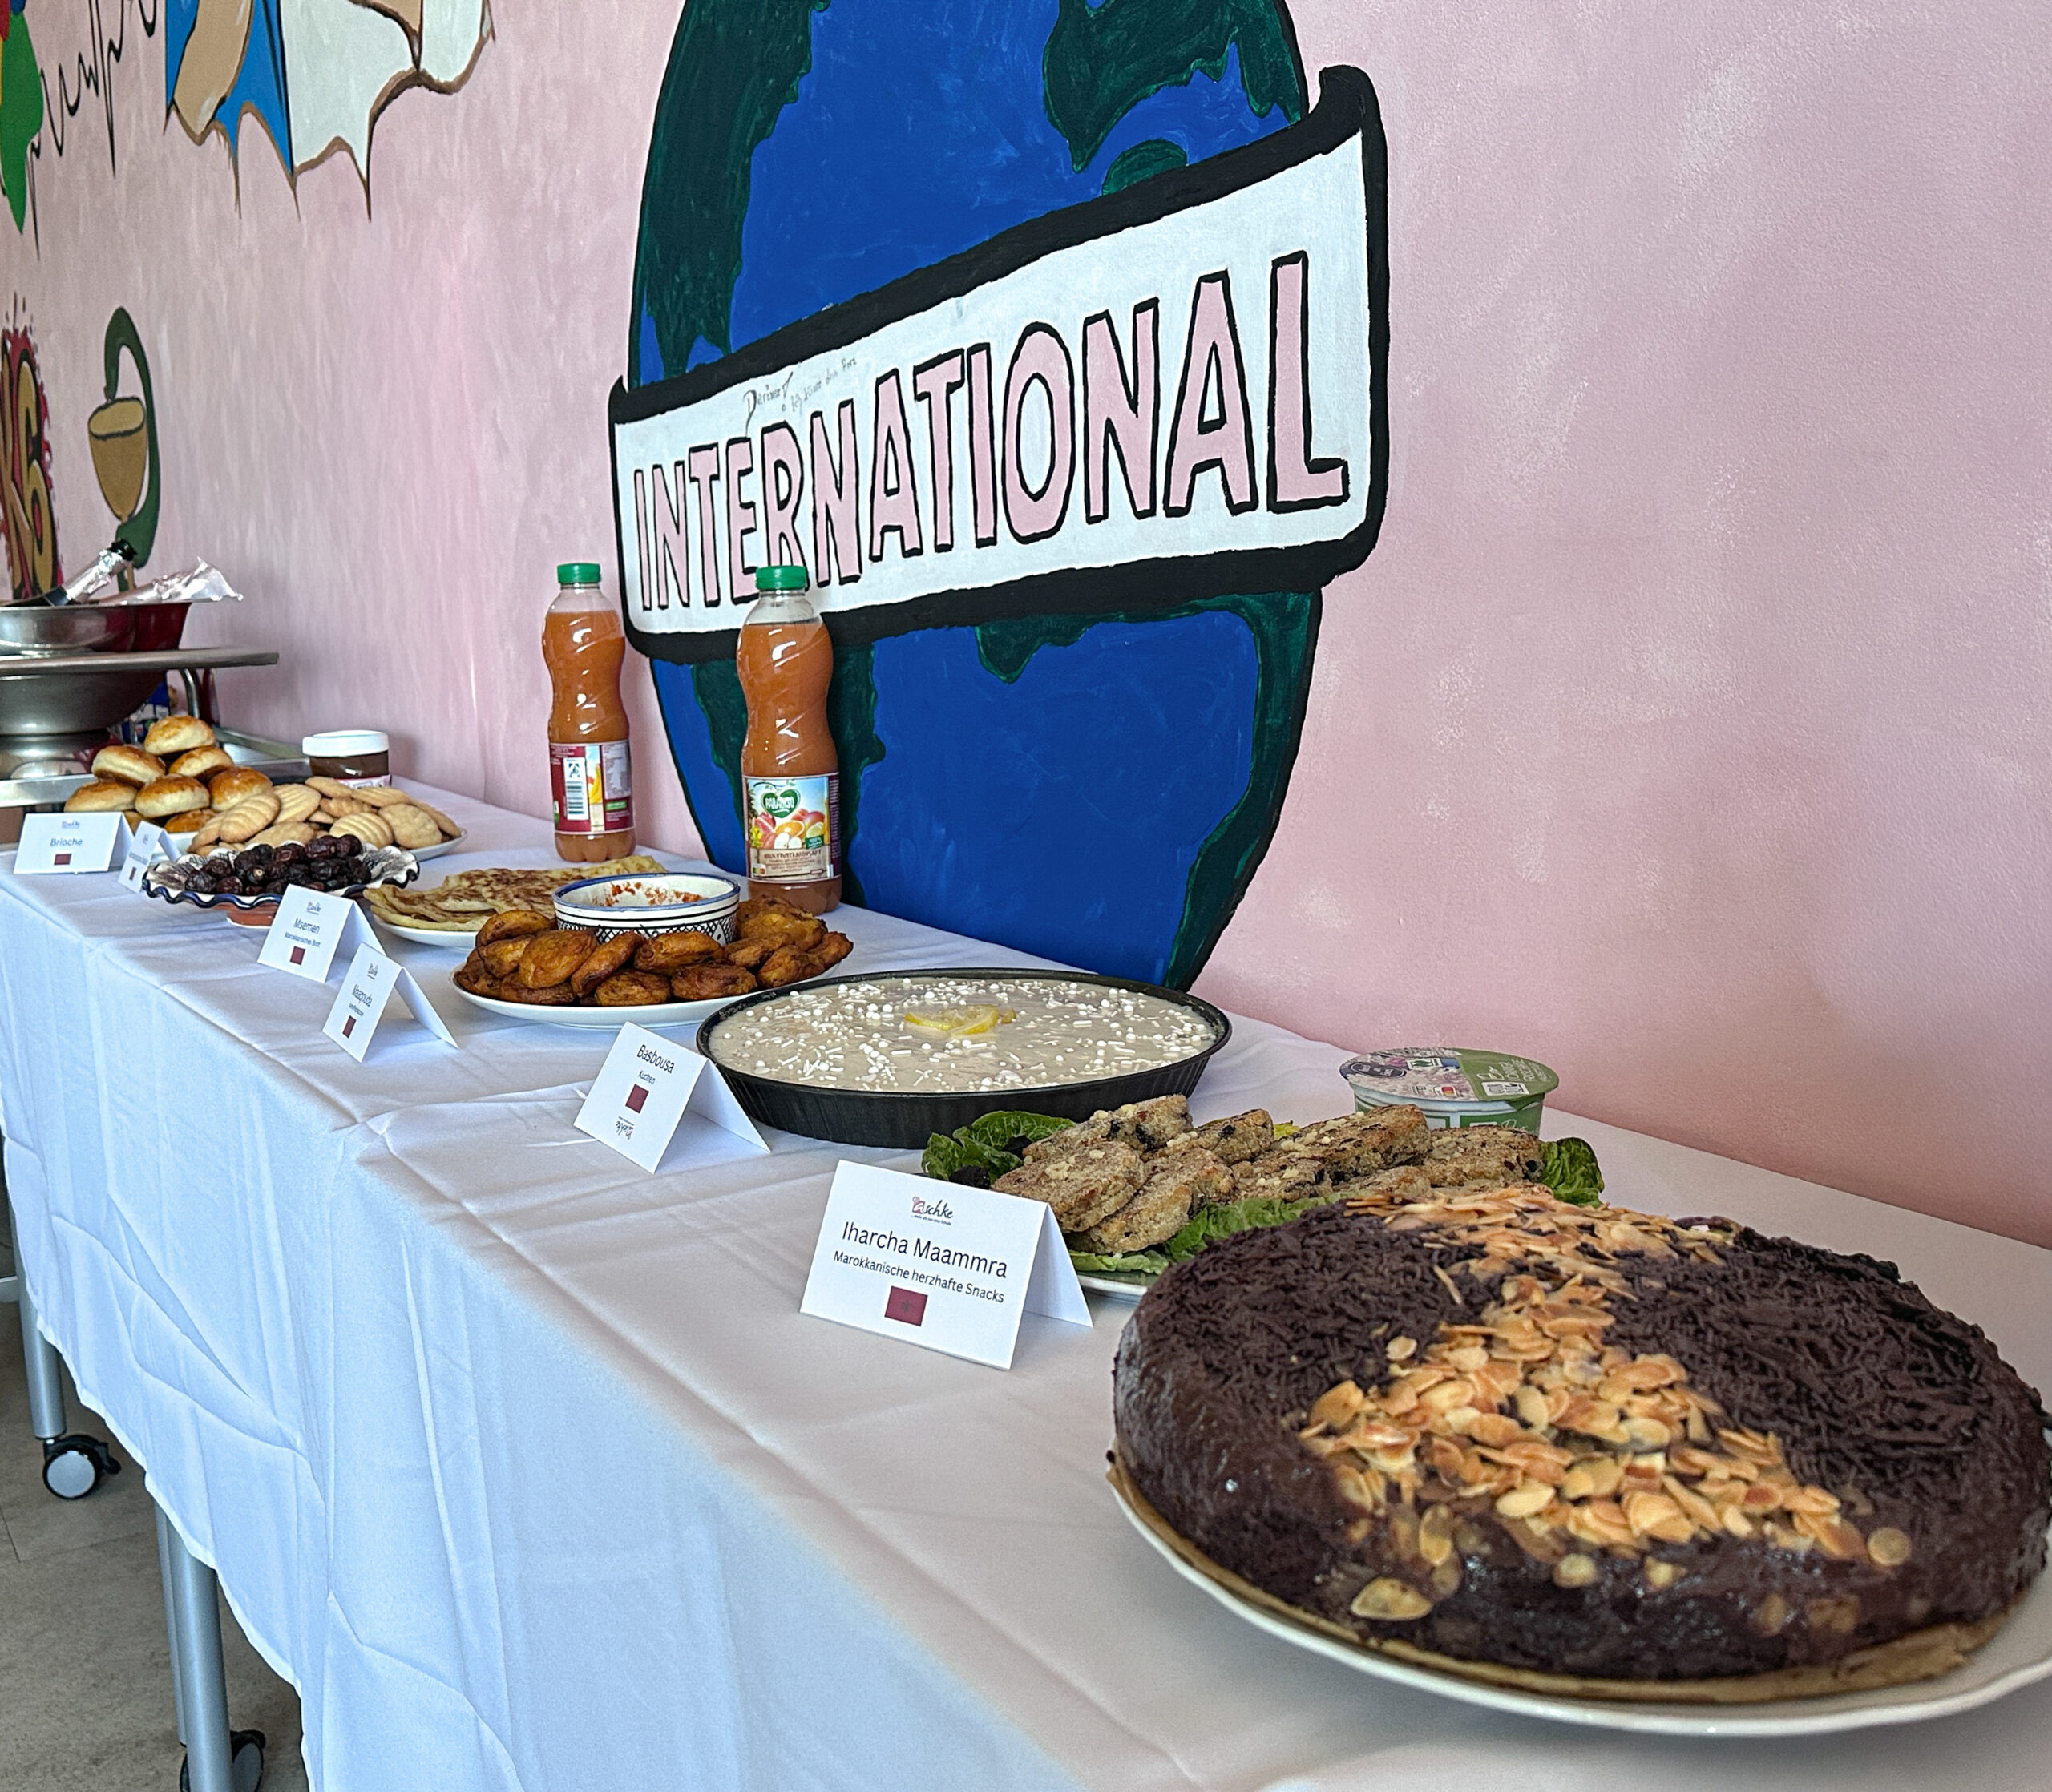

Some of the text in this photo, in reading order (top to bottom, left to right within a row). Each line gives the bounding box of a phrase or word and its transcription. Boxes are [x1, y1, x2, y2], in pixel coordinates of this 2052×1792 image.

[633, 251, 1348, 611] INTERNATIONAL
[50, 837, 83, 847] Brioche
[636, 1044, 675, 1073] Basbousa
[834, 1250, 1004, 1303] Marokkanische herzhafte Snacks
[842, 1221, 1008, 1279] Iharcha Maammra
